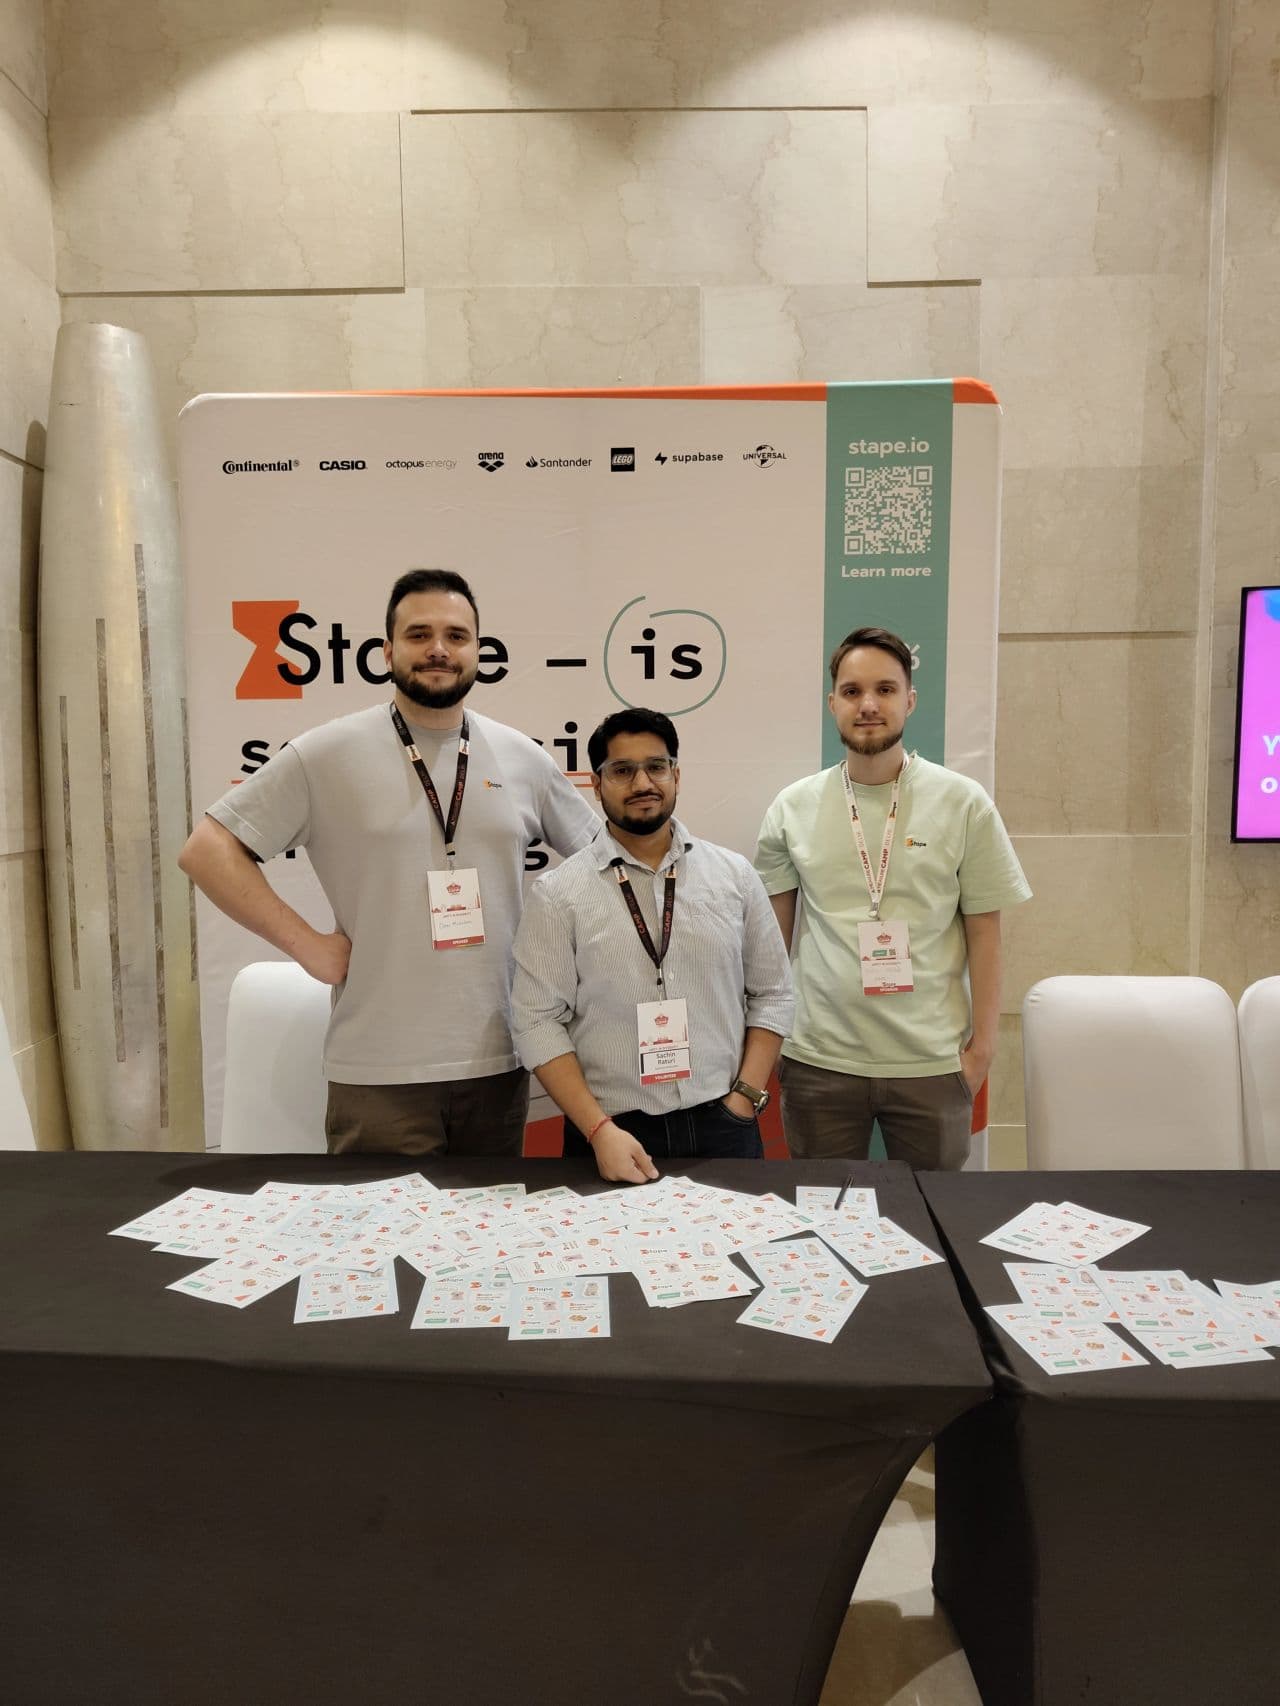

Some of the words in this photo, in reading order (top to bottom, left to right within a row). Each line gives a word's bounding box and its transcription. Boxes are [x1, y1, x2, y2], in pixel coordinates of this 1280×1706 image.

[848, 437, 930, 458] stape.io
[478, 452, 504, 460] arena
[611, 455, 633, 465] LEGO
[672, 452, 723, 462] supabase
[742, 452, 787, 461] UNIVERSAL
[319, 460, 366, 471] CASIO
[540, 457, 592, 468] Santander
[841, 565, 885, 578] Learn
[891, 565, 931, 577] more
[277, 612, 509, 686] Stae
[631, 628, 703, 680] is
